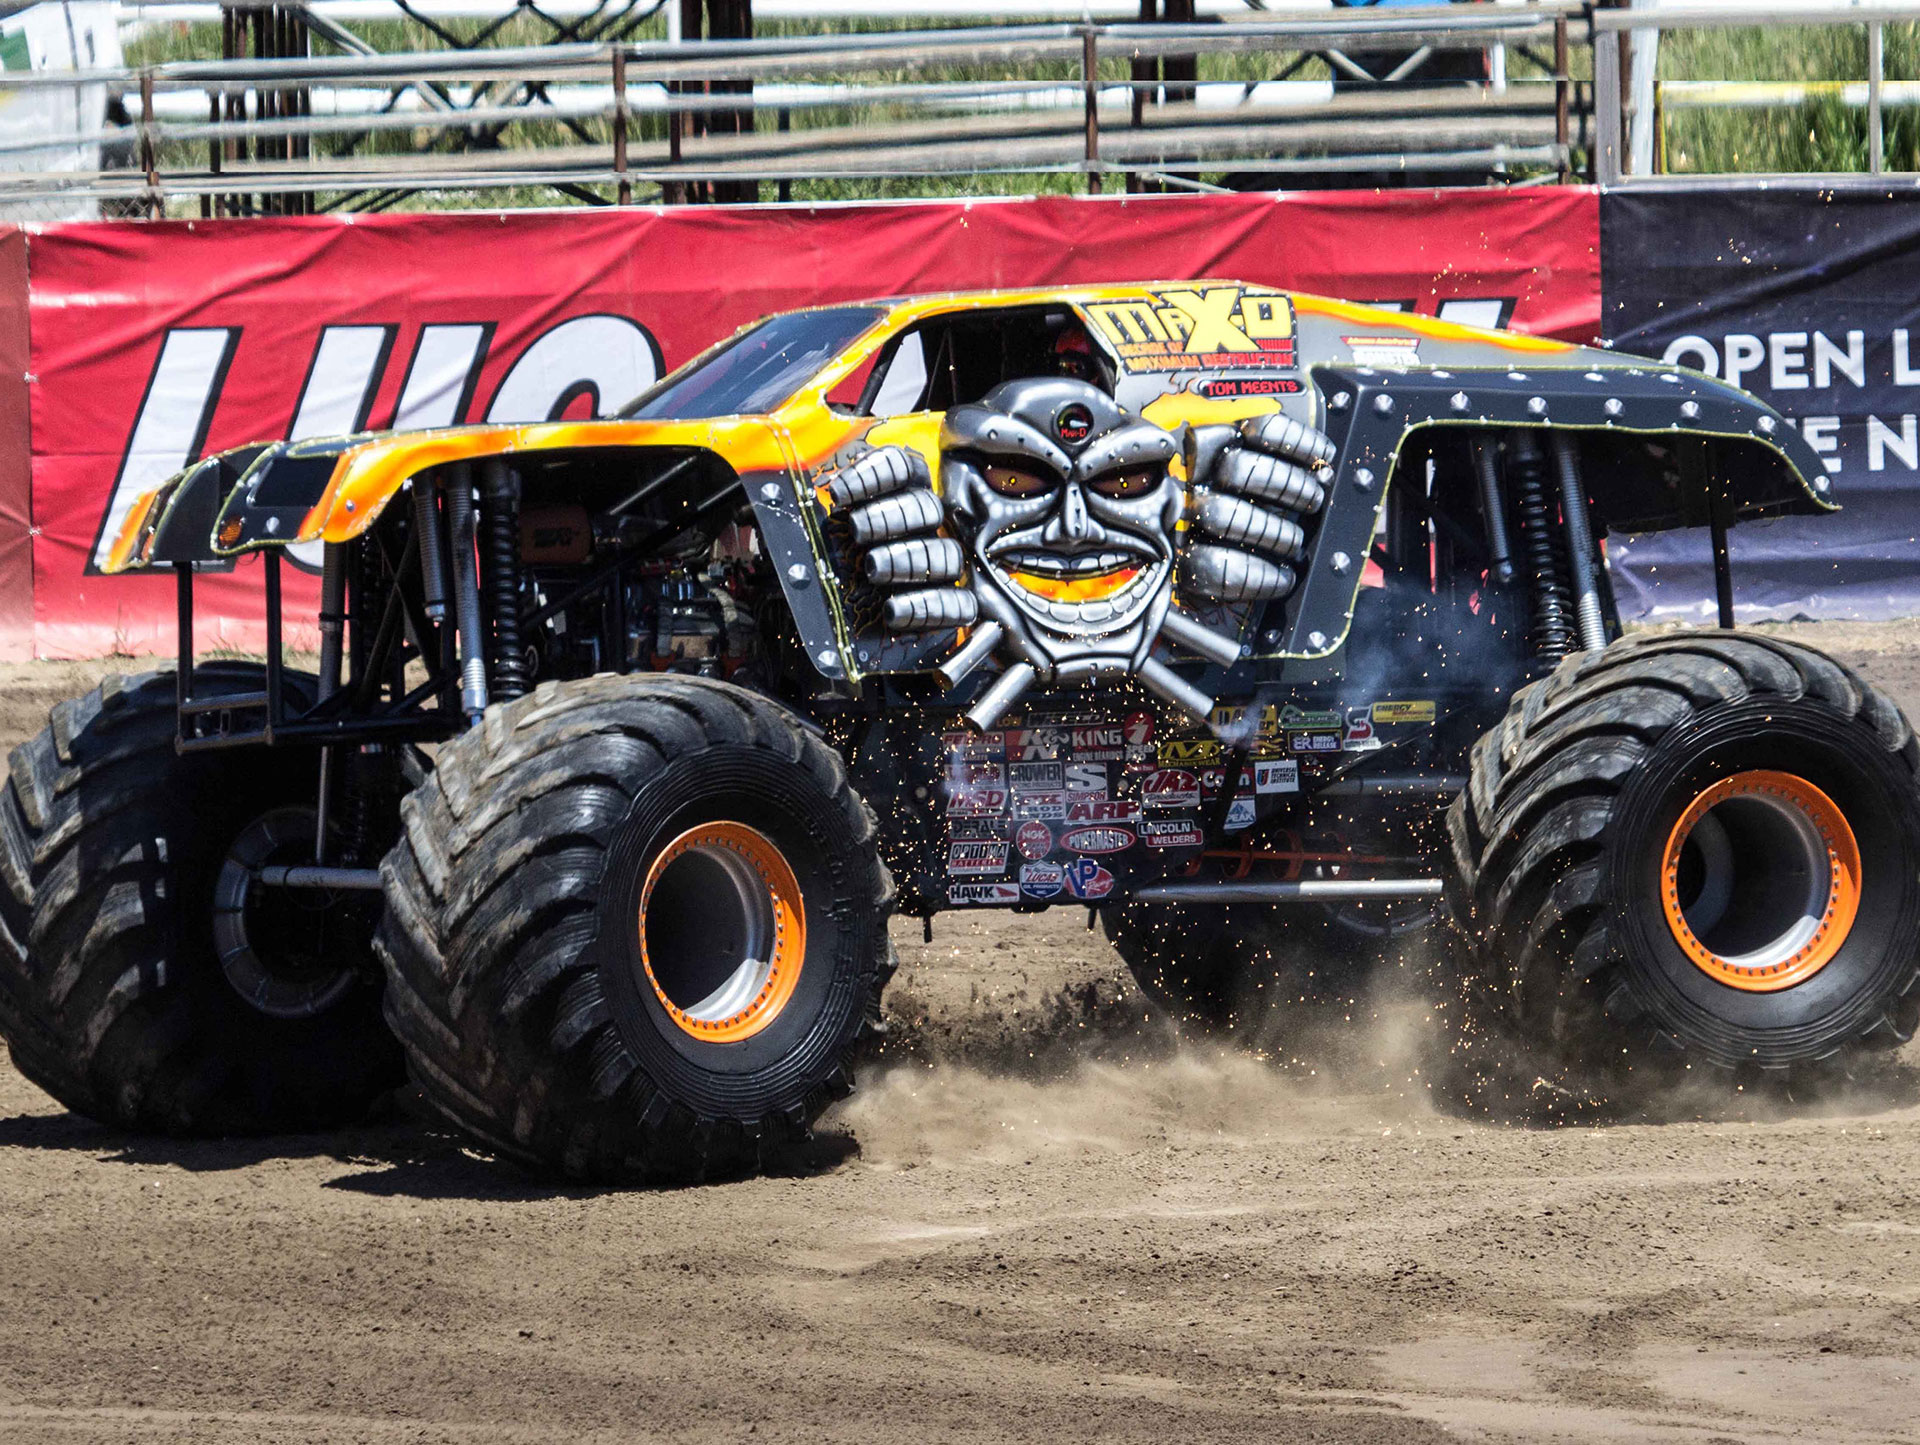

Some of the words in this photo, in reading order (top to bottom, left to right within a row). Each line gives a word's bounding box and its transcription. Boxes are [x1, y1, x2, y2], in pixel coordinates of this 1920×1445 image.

[1115, 342, 1167, 357] DECADE
[1166, 342, 1185, 354] OF
[1125, 353, 1200, 370] MAXIMUM
[1201, 350, 1294, 368] DESTRUCTION
[1662, 329, 1866, 389] OPEN
[1208, 381, 1237, 397] TOM
[1241, 380, 1299, 395] MEENTS
[1071, 729, 1123, 747] KING
[1127, 744, 1156, 754] SPEED
[1200, 756, 1221, 767] WEAR
[1143, 770, 1199, 793] JAZ
[949, 790, 1005, 809] MSD
[1067, 792, 1107, 802] SIMPSON
[1069, 802, 1141, 821] ARP
[1229, 811, 1253, 820] PEAK
[1021, 830, 1046, 840] NGK
[1140, 822, 1191, 835] LINCOLN
[1068, 830, 1130, 851] POWERMASTER
[1152, 835, 1197, 845] WELDERS
[952, 843, 1007, 860] OPTIMA
[951, 859, 1005, 868] BATTERIES
[1025, 871, 1059, 884] LUCAS
[950, 885, 995, 900] HAWK
